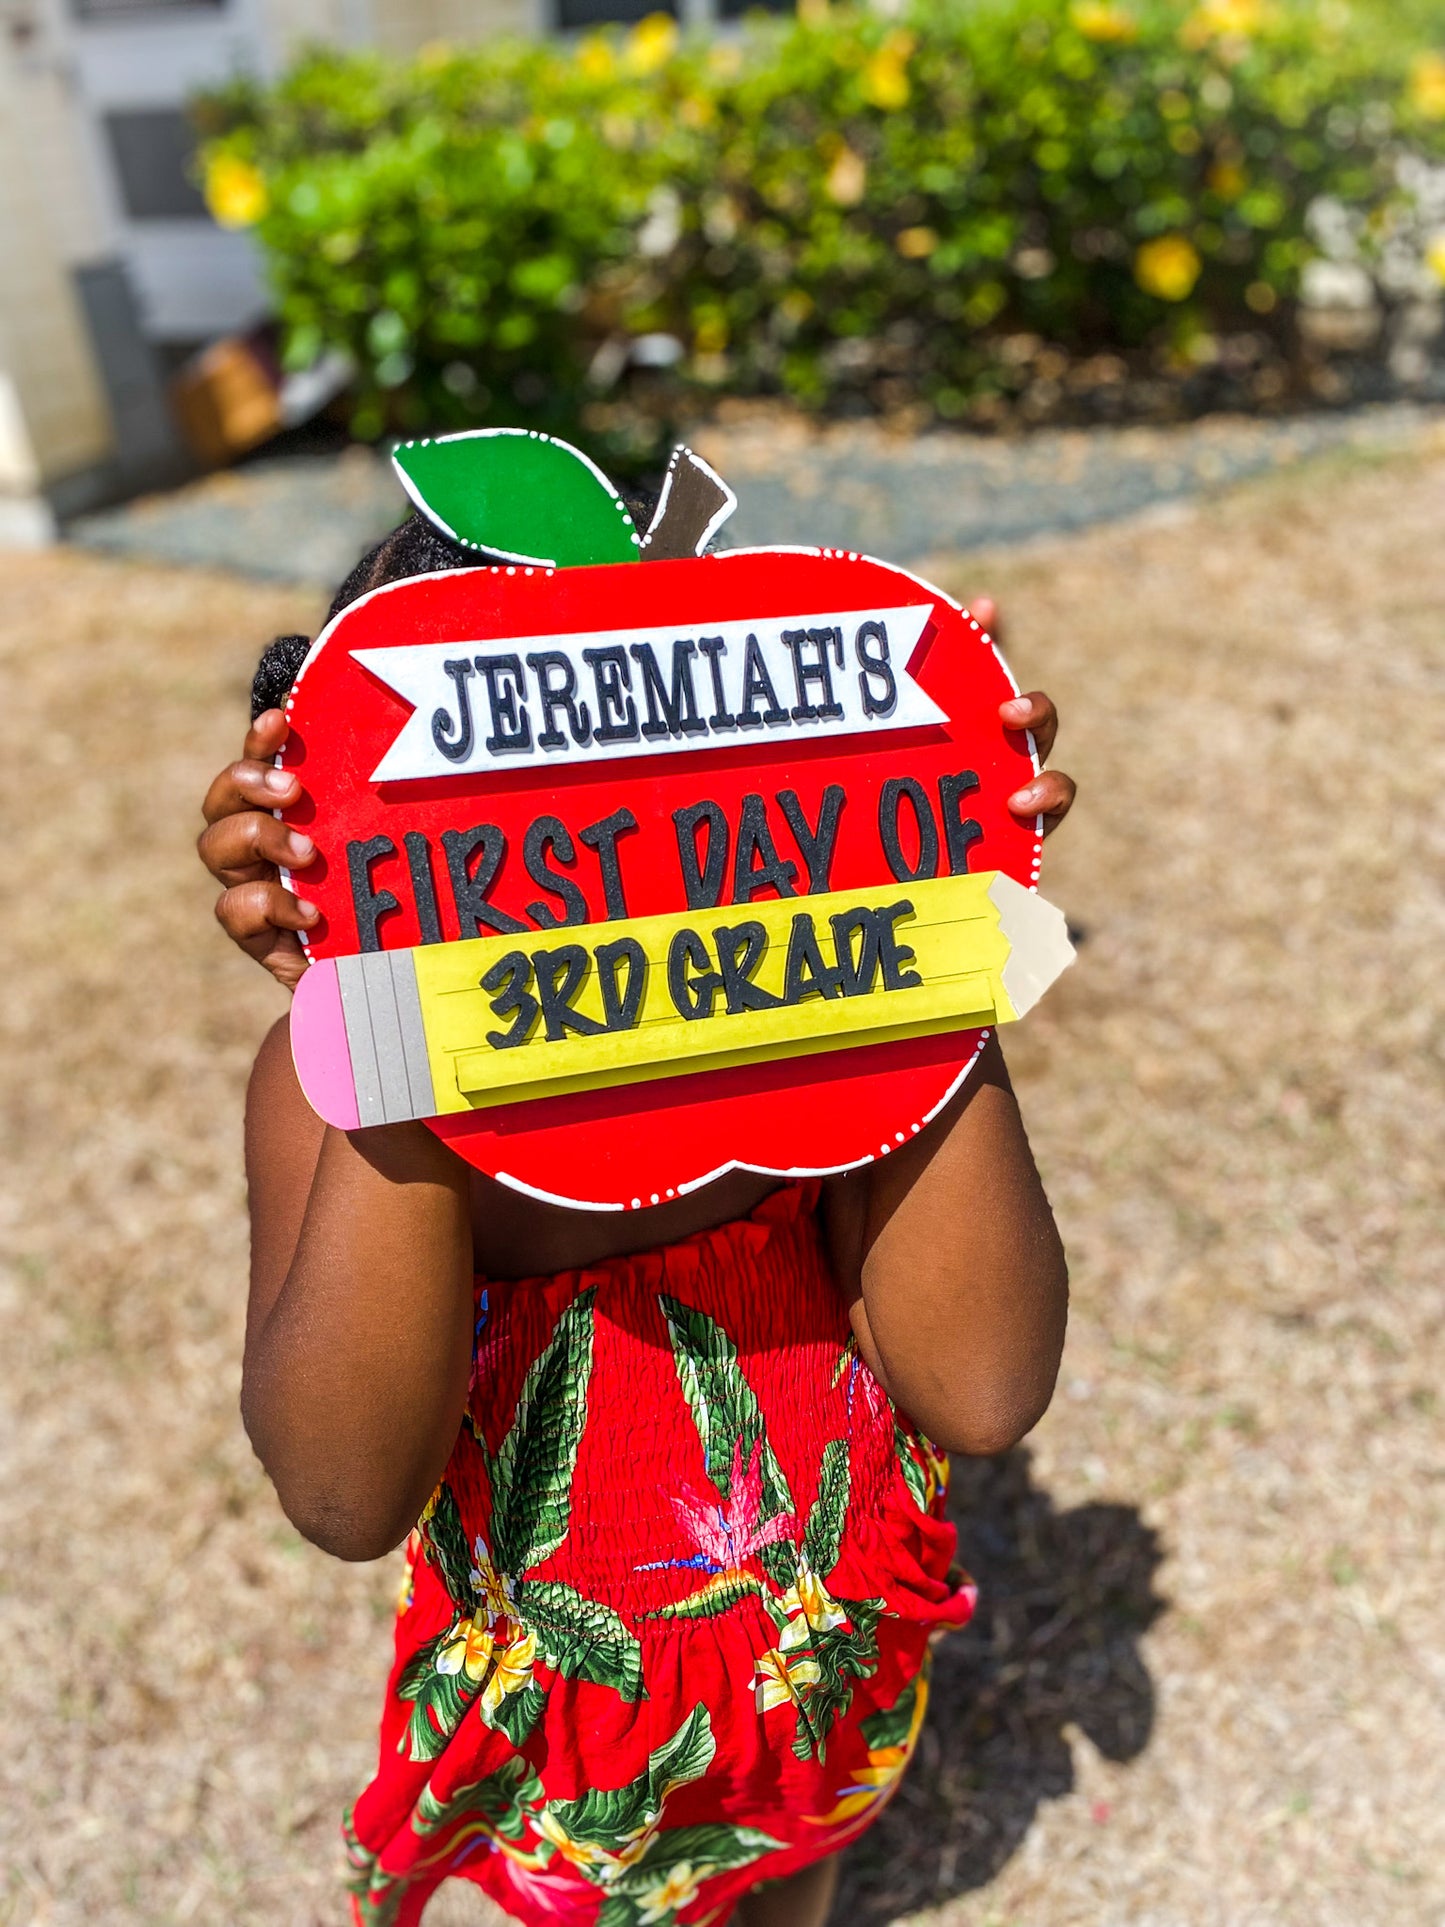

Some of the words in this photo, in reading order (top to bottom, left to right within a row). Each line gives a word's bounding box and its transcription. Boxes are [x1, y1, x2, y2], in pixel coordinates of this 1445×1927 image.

[431, 620, 897, 760] JEREMIAH'S
[346, 808, 636, 952] FIRST
[672, 785, 845, 910] DAY
[878, 770, 982, 883] OF
[478, 938, 644, 1050] 3RD
[668, 900, 923, 1020] GRADE
